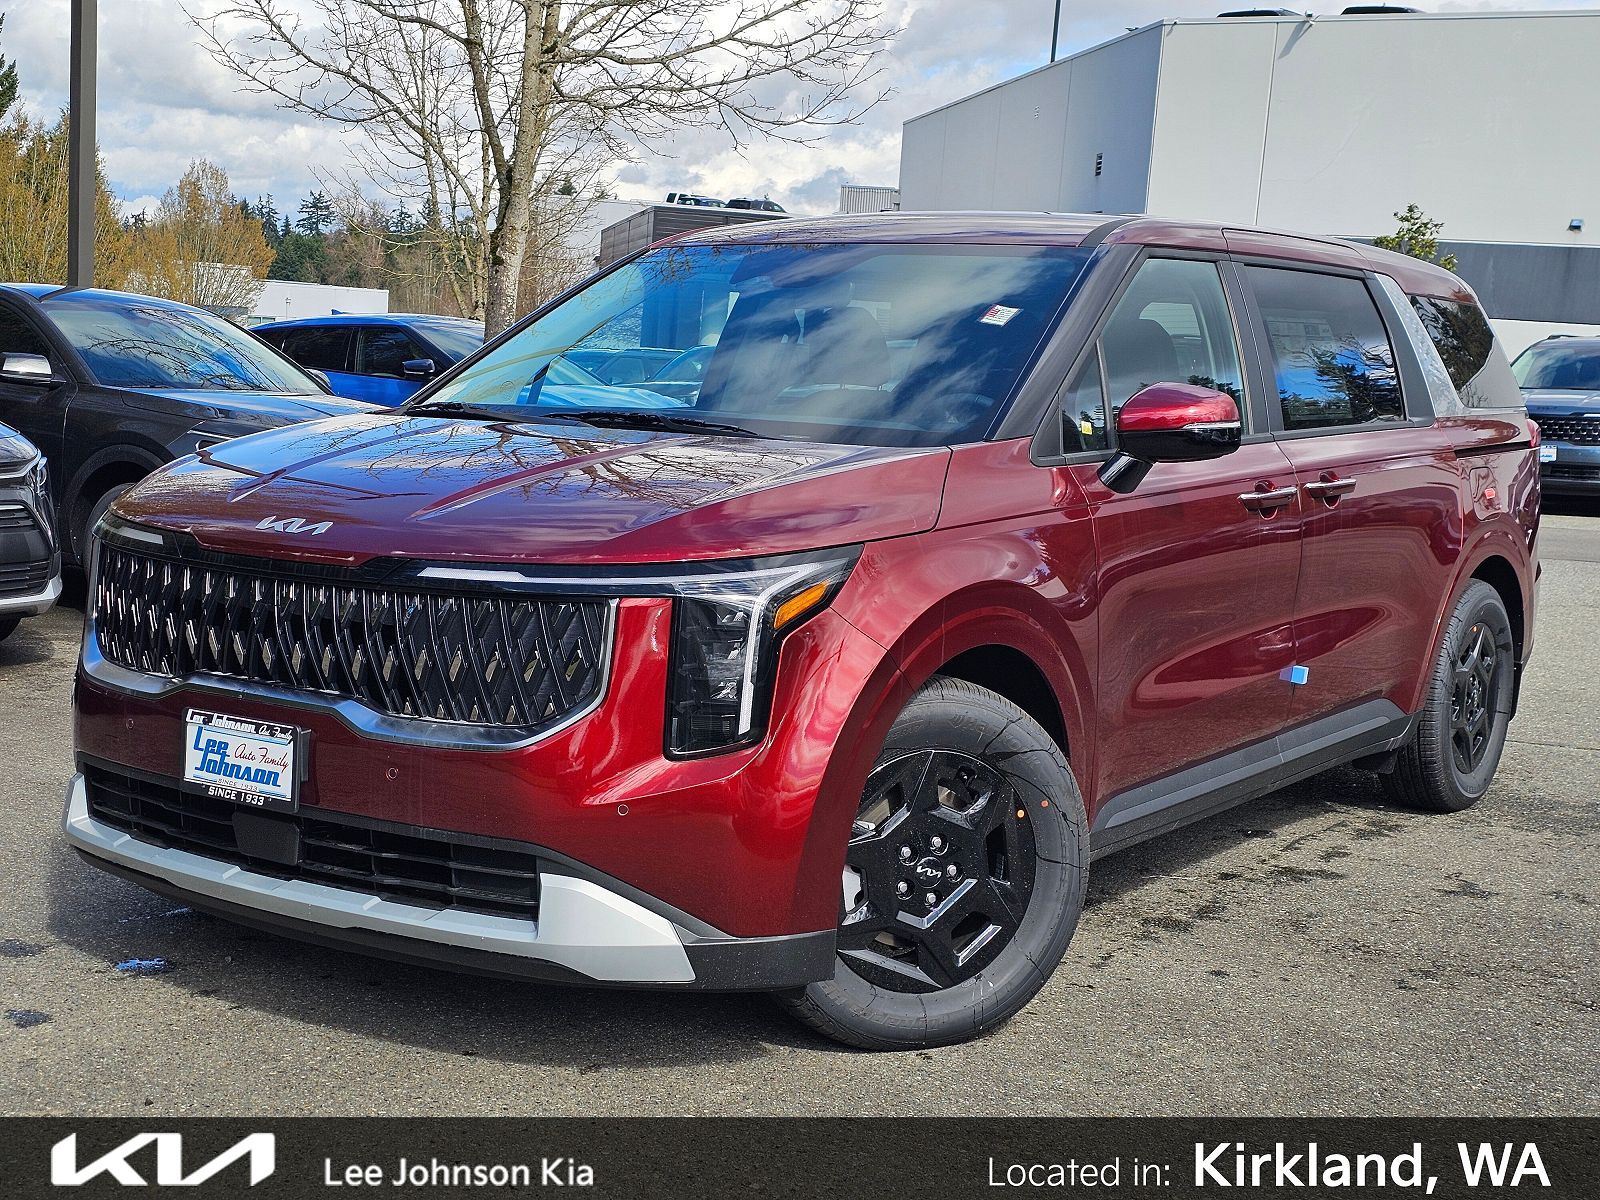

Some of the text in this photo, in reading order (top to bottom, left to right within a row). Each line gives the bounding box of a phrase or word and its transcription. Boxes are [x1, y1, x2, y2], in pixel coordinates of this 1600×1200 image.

[193, 726, 289, 773] Lee Auto Family
[194, 749, 282, 788] Johnson
[207, 786, 265, 806] SINCE 1933
